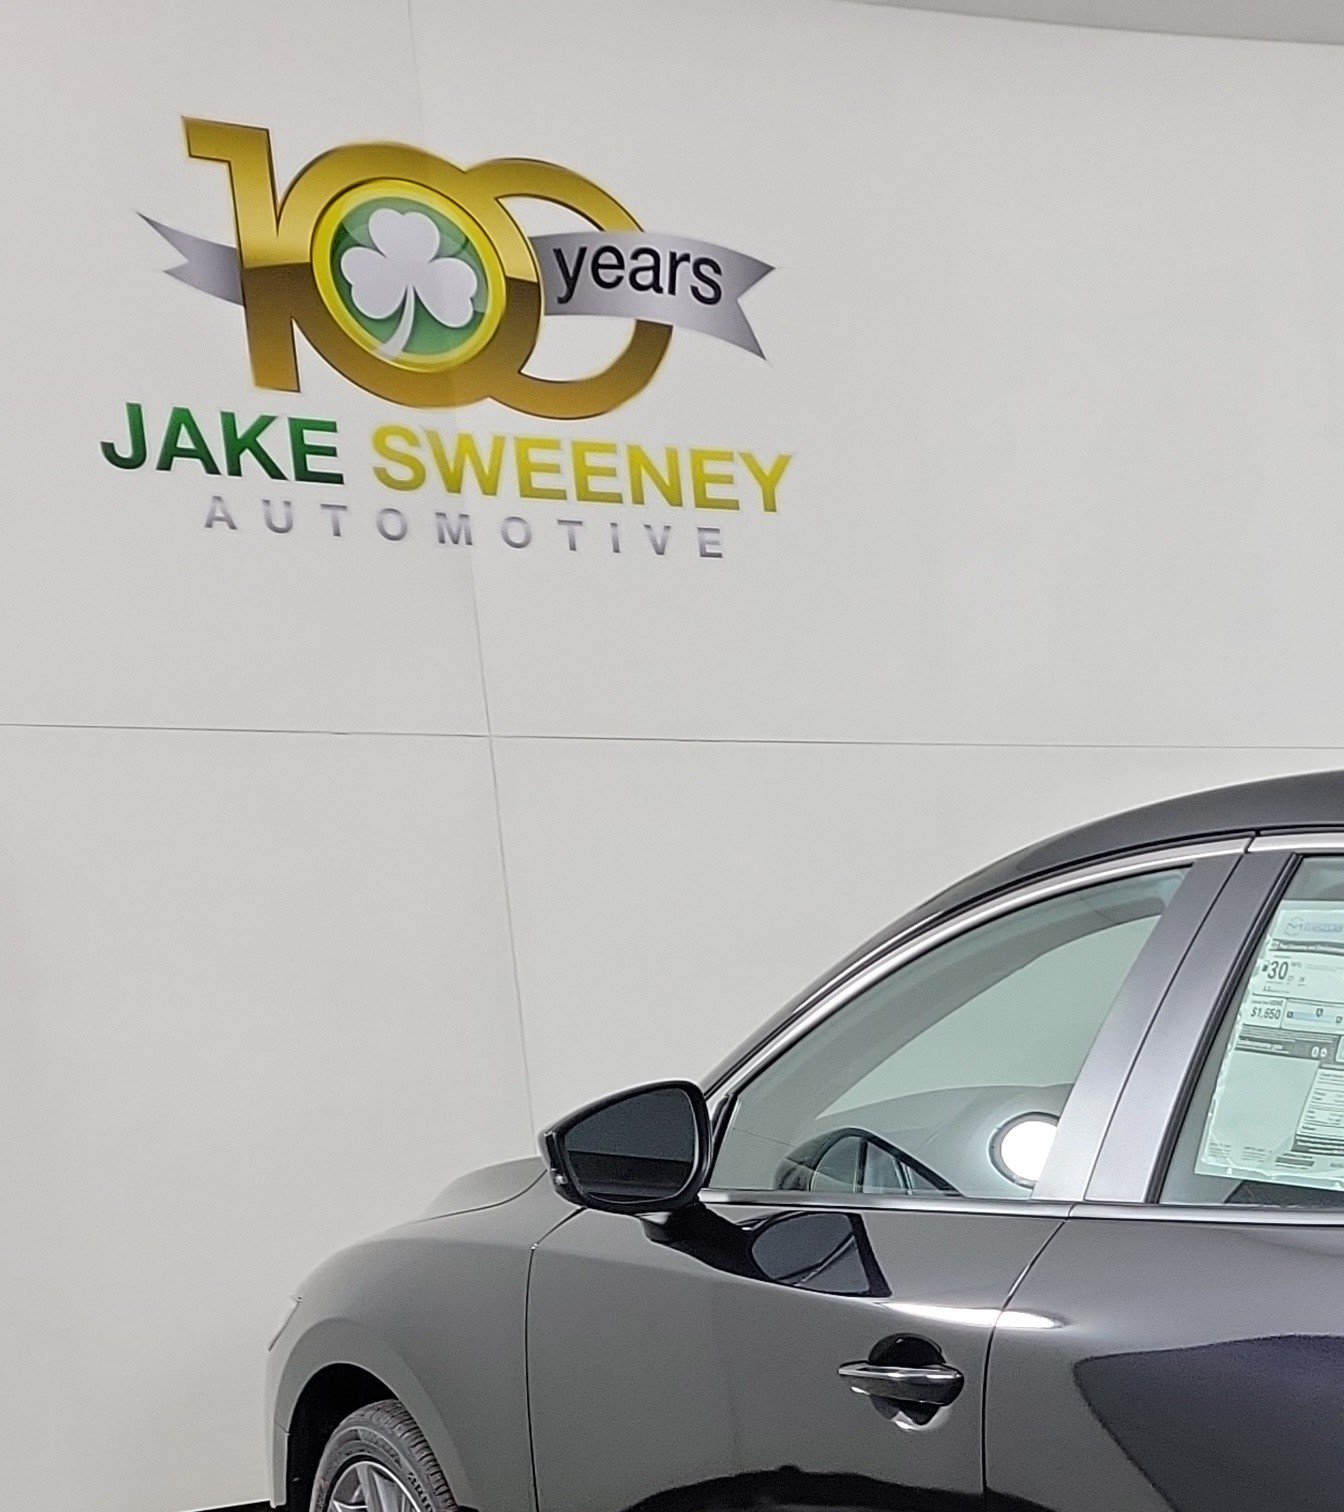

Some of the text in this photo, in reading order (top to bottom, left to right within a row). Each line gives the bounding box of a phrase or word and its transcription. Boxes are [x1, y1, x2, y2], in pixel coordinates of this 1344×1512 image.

[552, 240, 724, 306] years
[99, 402, 794, 513] JAKE SWEENEY
[203, 495, 725, 560] AUTOMOTIVE
[1268, 961, 1289, 980] 30
[1250, 1006, 1281, 1020] $1,650
